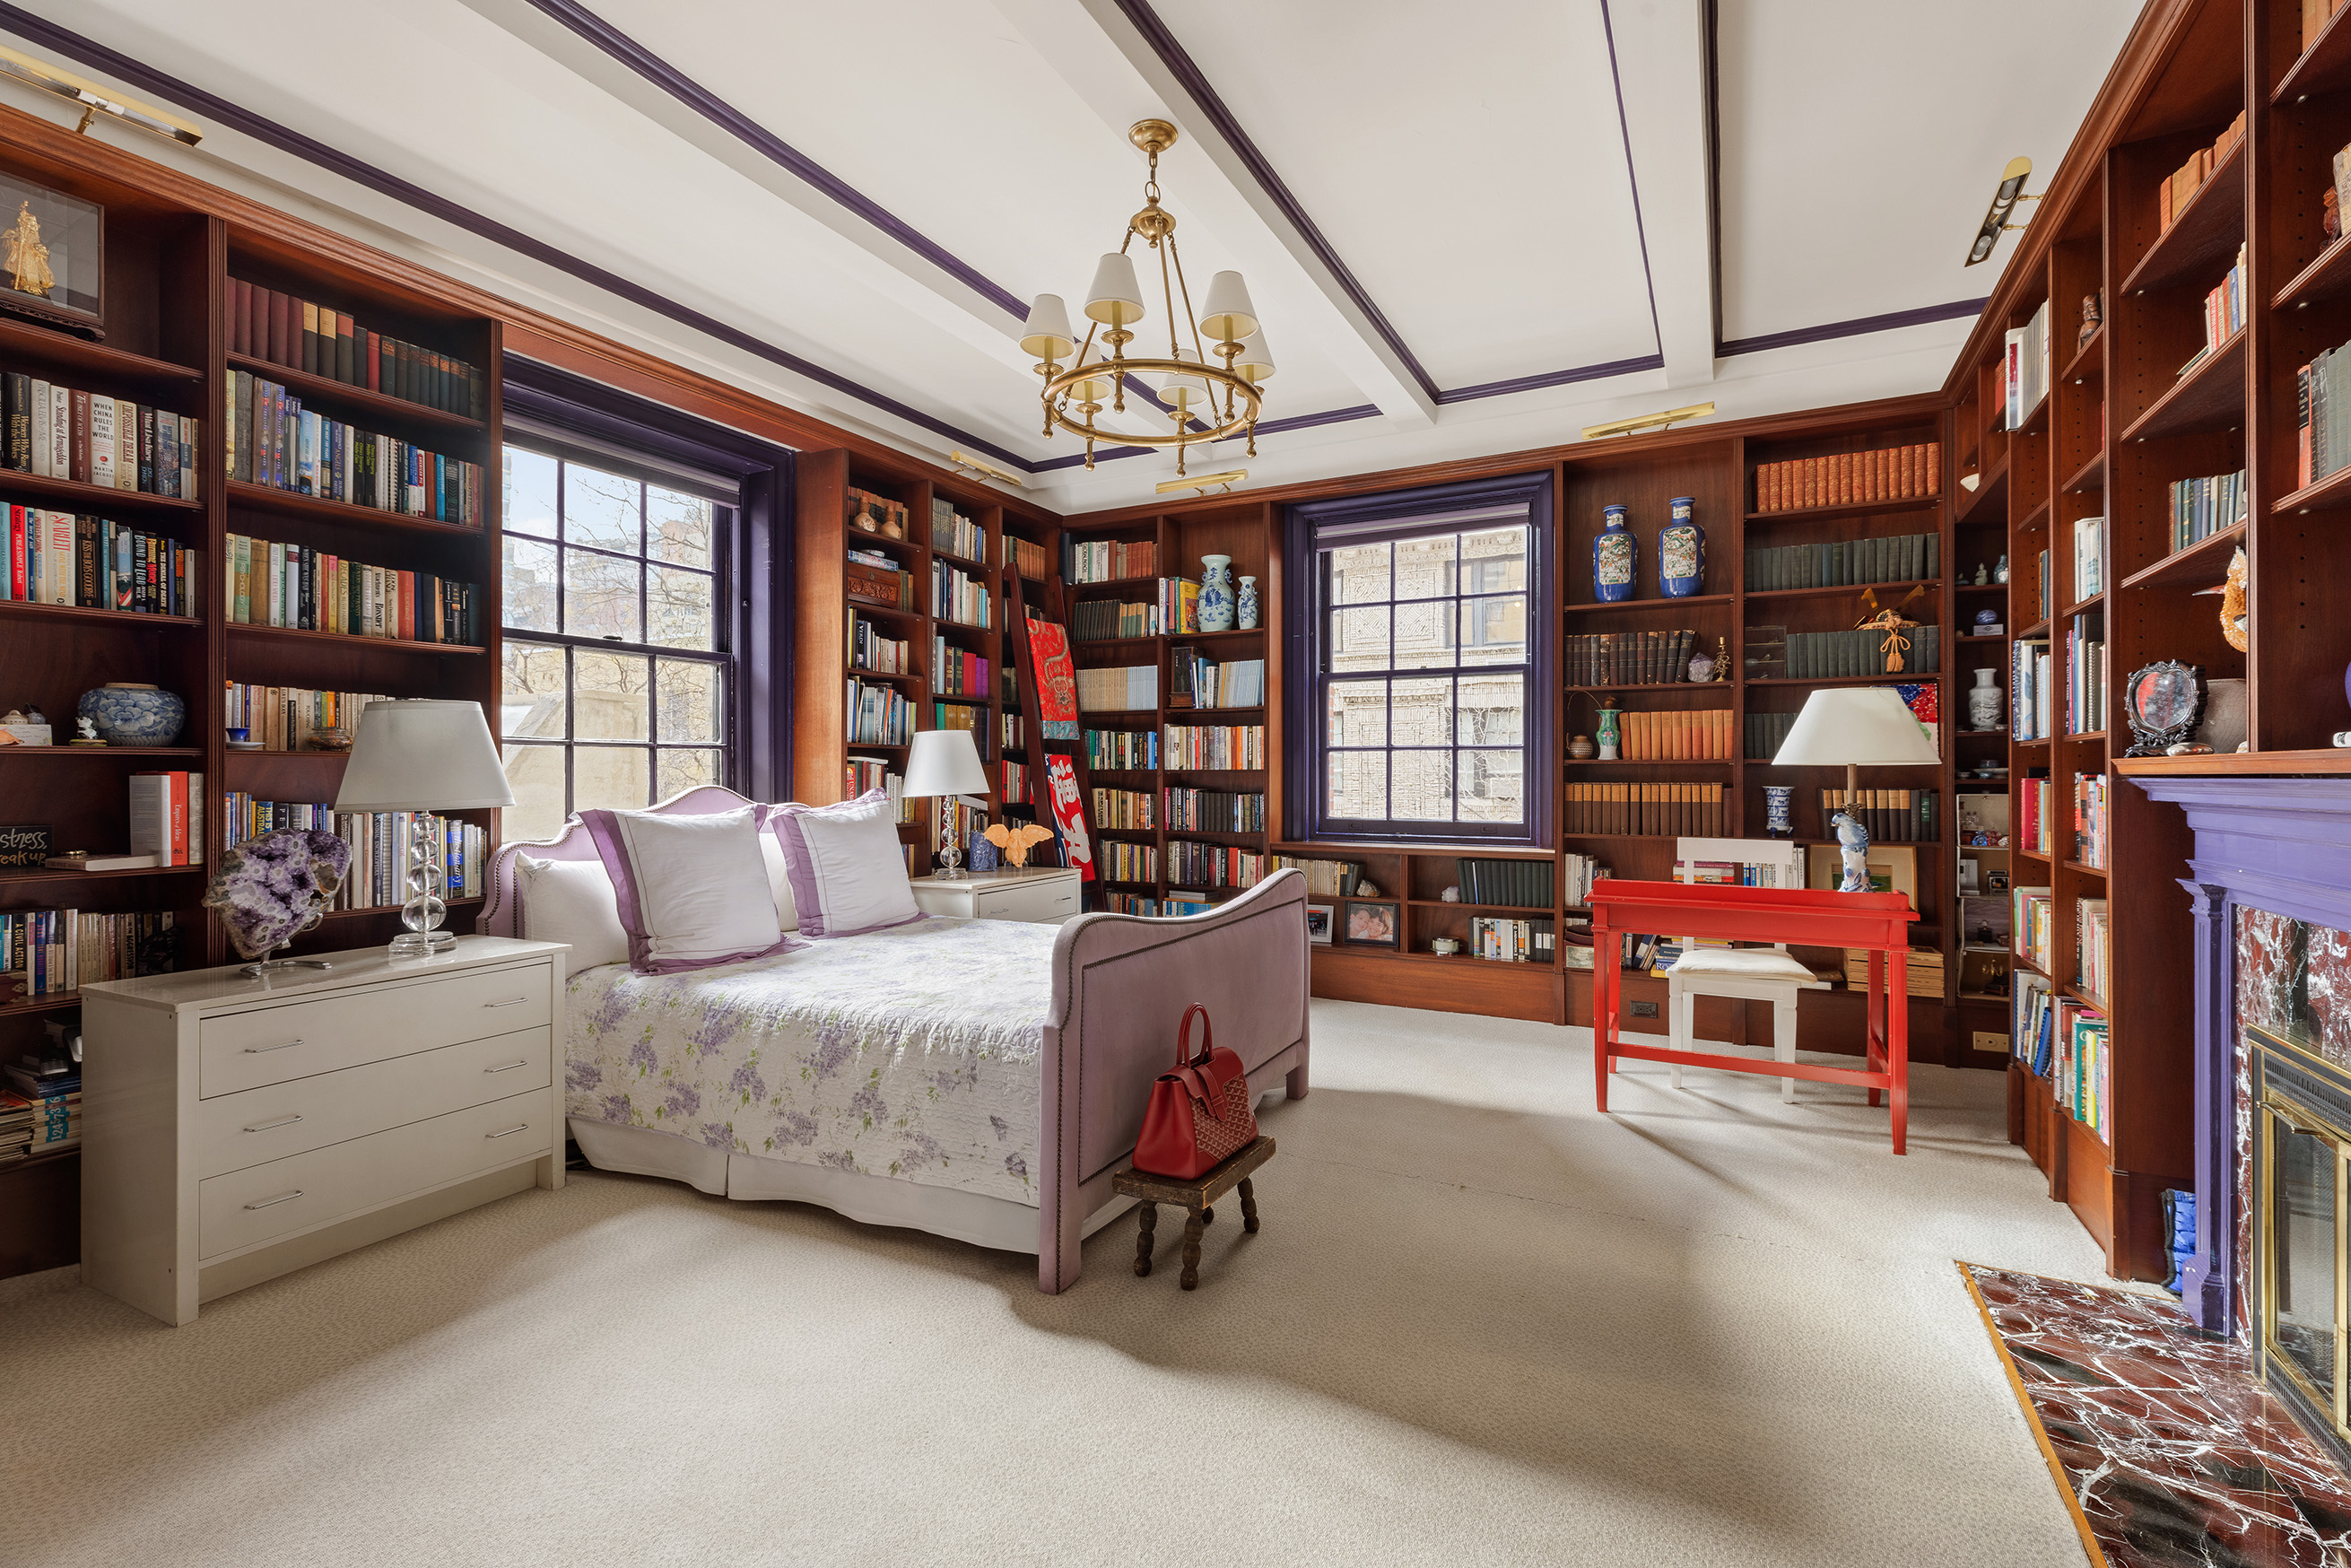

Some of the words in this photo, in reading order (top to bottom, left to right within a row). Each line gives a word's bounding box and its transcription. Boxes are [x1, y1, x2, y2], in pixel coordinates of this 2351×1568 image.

[54, 405, 66, 428] Standing
[94, 403, 112, 411] WHEN
[94, 410, 113, 418] CHINA
[12, 414, 20, 429] With
[21, 416, 29, 438] Women
[94, 417, 113, 425] RULES
[122, 405, 133, 440] IMPOSSIBLE
[21, 439, 29, 452] Who
[92, 432, 114, 440] WORLD
[12, 440, 20, 458] Wolves
[54, 434, 66, 465] Armageddon
[123, 440, 134, 464] DREAM
[21, 454, 29, 466] Run
[93, 471, 114, 479] JACQUES
[13, 508, 22, 531] Strategy
[49, 515, 71, 552] SCARLETT
[83, 540, 92, 552] KISS
[135, 535, 146, 557] BOUND
[146, 538, 157, 563] Burning
[83, 559, 92, 572] BOYS
[146, 563, 157, 585] Money
[83, 572, 93, 597] GOODBYE
[135, 569, 146, 585] LEAD
[340, 562, 348, 595] DECADES
[375, 603, 384, 628] Rossner
[173, 804, 181, 823] Empires
[0, 828, 48, 849] stress,
[0, 849, 28, 866] reak
[15, 929, 23, 945] CIVIL
[15, 947, 23, 968] ACTION
[126, 935, 135, 970] AGGRESSION
